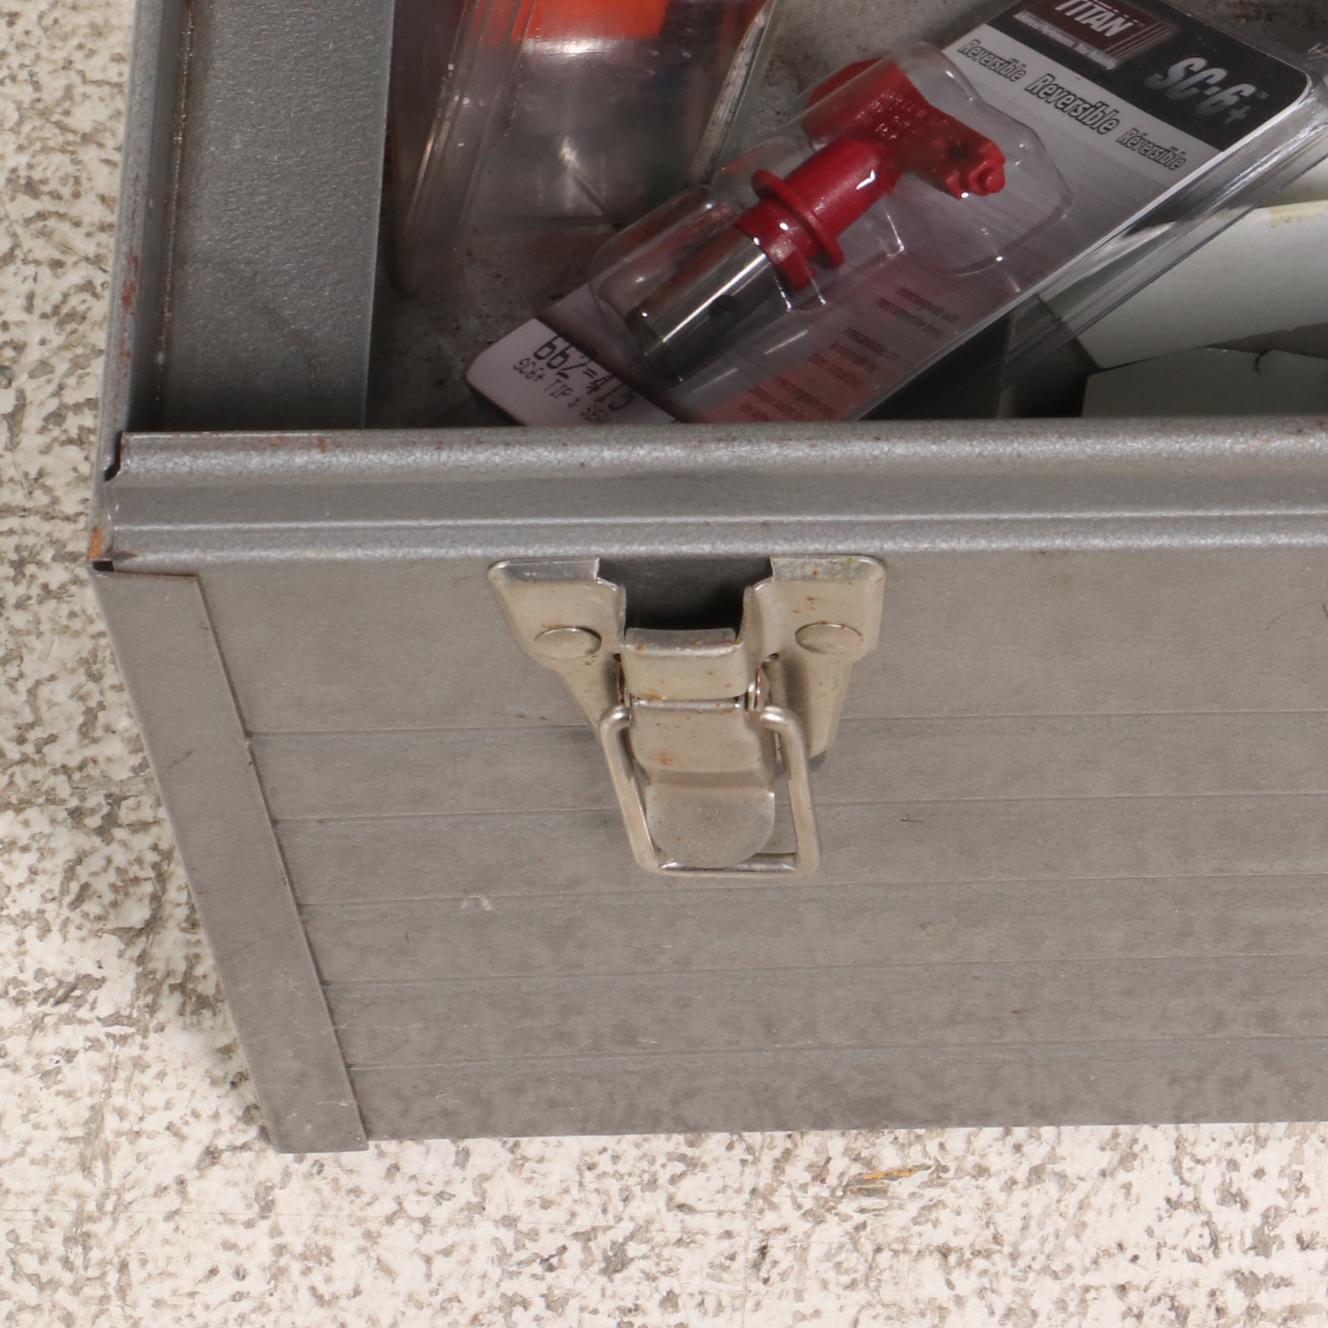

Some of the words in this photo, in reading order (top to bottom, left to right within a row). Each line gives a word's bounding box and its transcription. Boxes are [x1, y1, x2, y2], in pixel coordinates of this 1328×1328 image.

[957, 39, 1026, 82] Reversible
[1025, 73, 1120, 135] Reversible
[1116, 128, 1187, 171] Réversible
